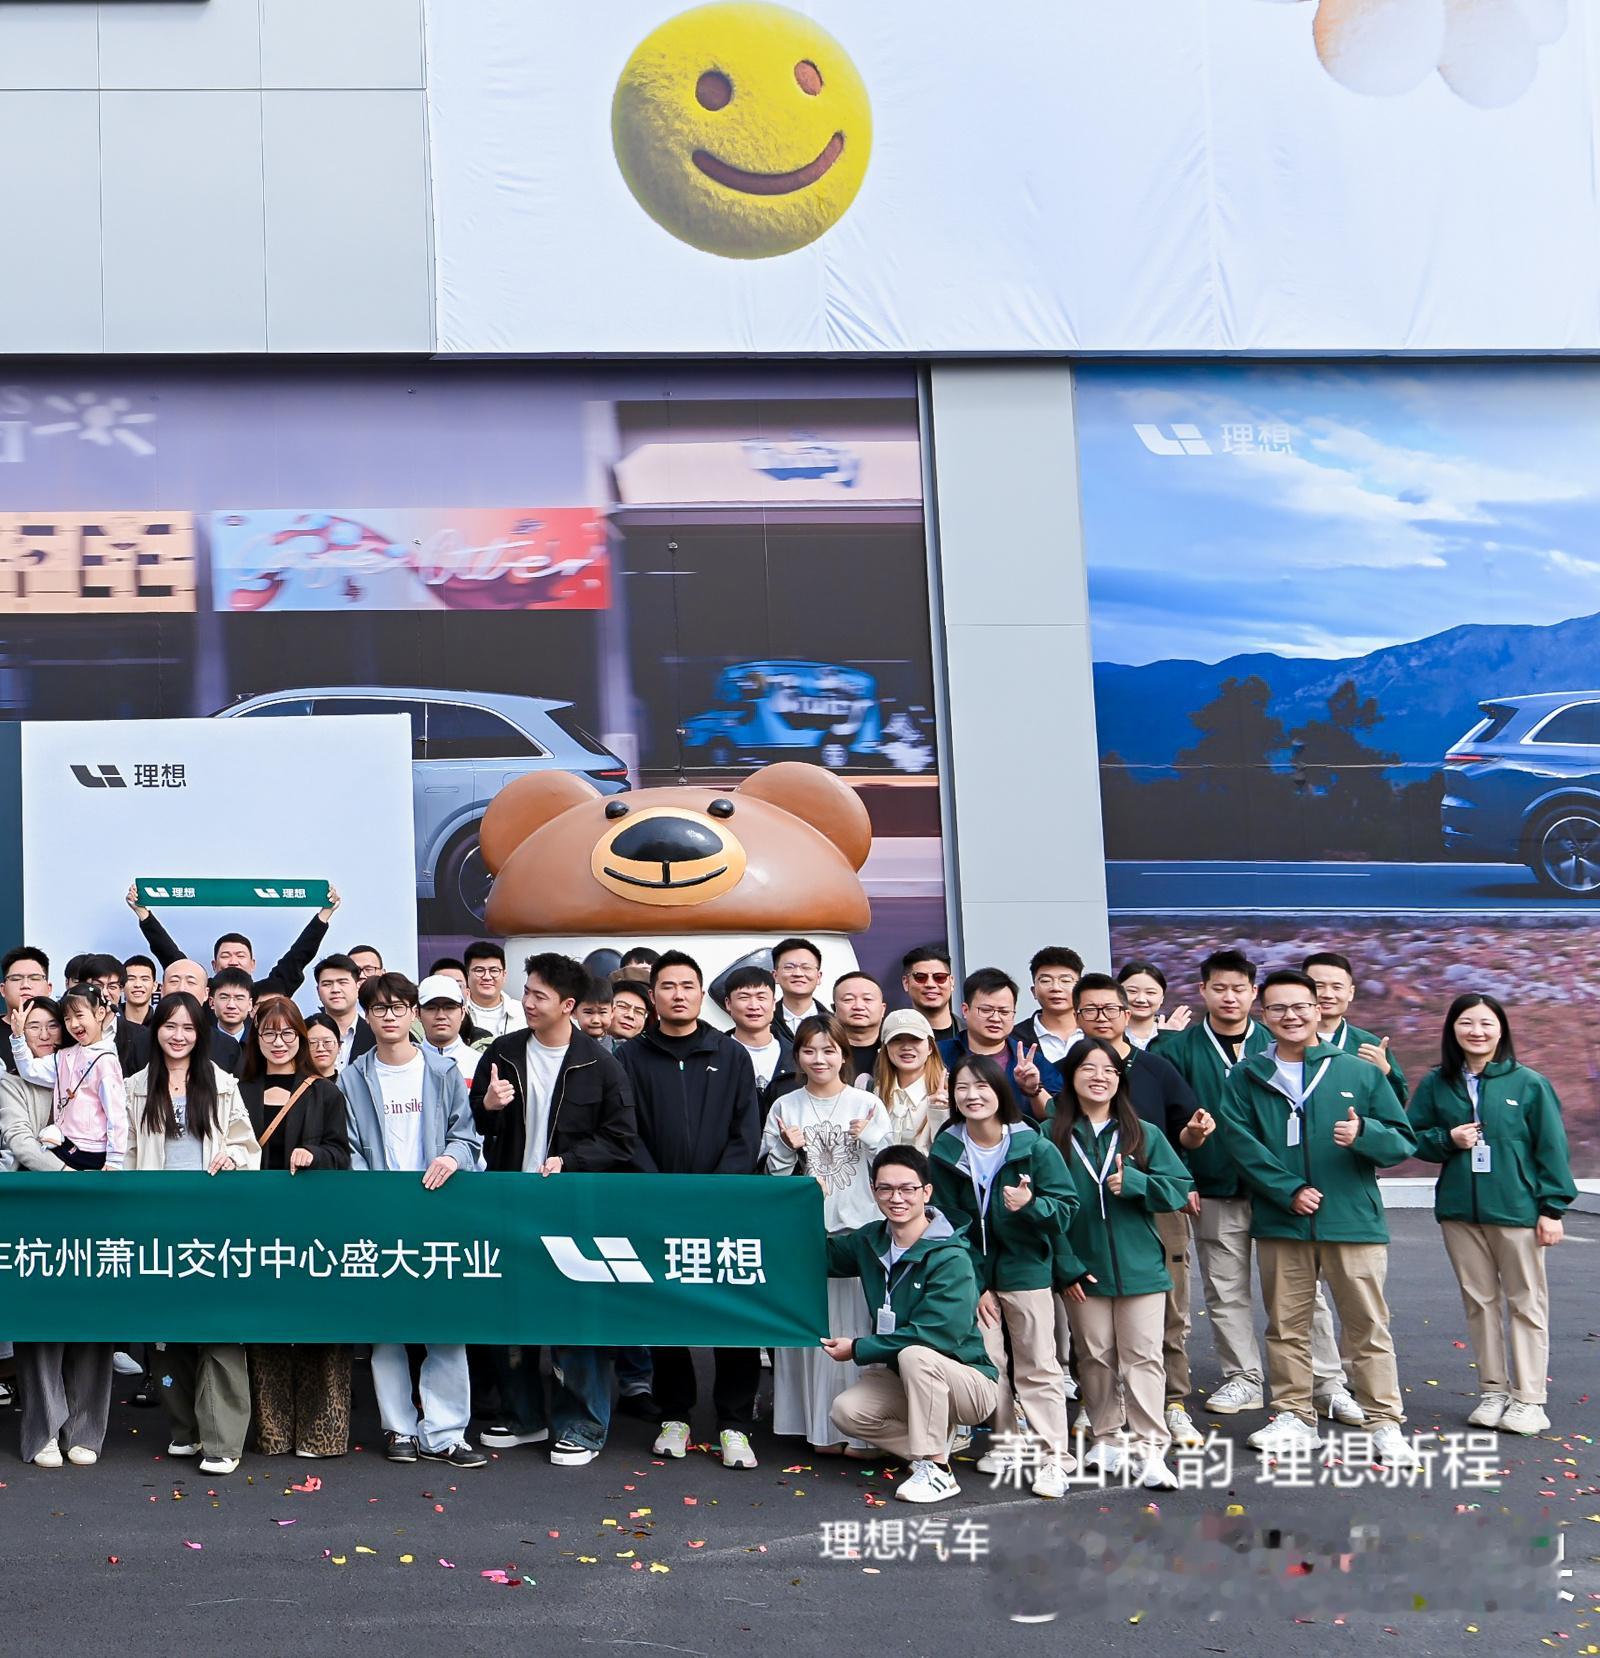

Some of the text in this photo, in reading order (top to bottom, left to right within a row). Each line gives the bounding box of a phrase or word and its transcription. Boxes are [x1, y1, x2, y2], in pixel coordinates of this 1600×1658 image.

[1221, 423, 1293, 456] 理想
[134, 763, 187, 788] 理想
[172, 887, 196, 898] 理想
[282, 888, 307, 899] 理想
[391, 1099, 403, 1114] in
[405, 1098, 424, 1113] sile
[664, 1236, 767, 1285] 理想
